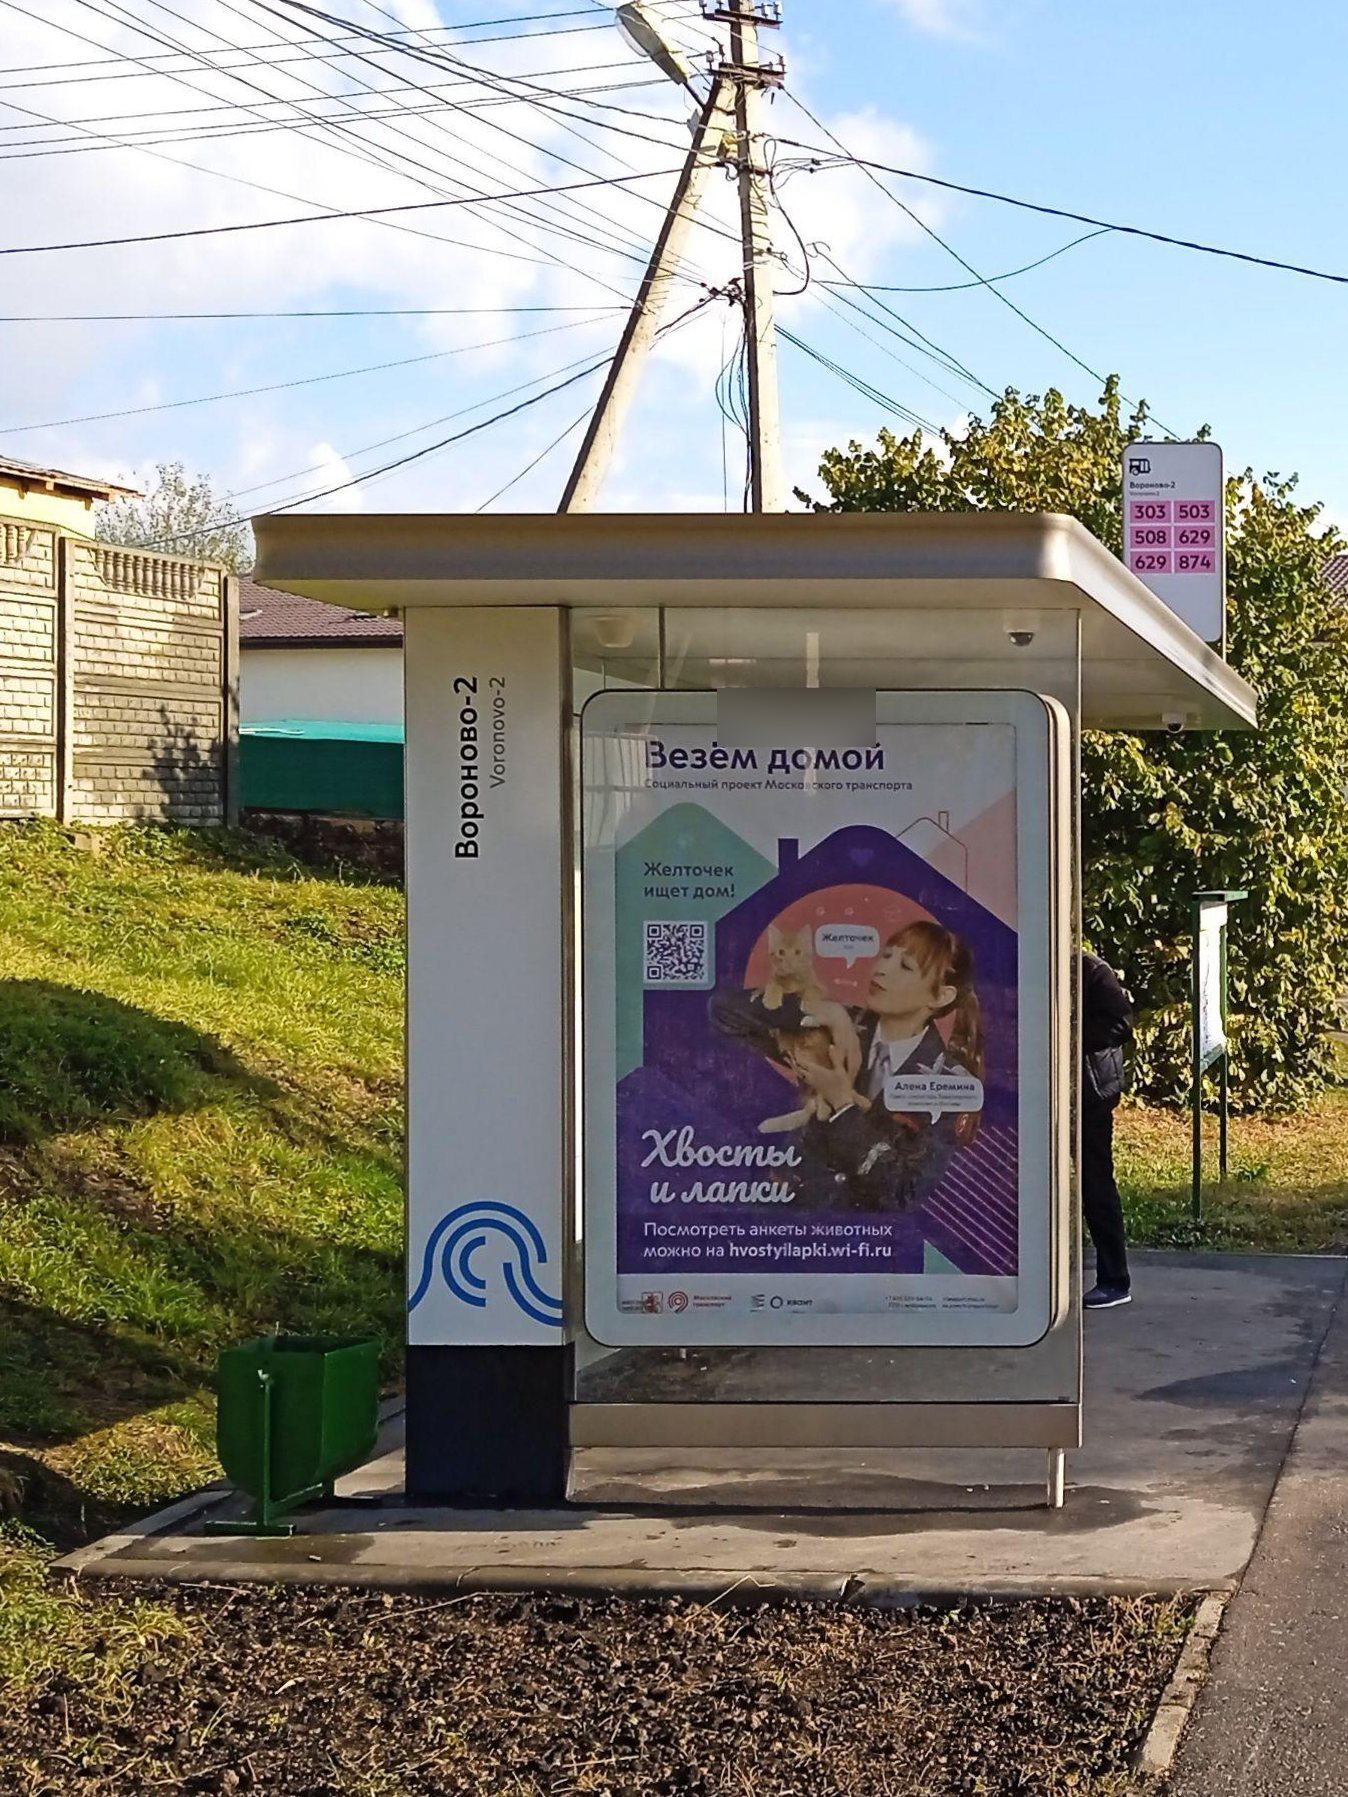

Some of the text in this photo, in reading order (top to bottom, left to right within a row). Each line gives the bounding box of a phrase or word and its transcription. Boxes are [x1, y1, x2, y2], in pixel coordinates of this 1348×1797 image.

[1134, 504, 1210, 519] 303 503
[1135, 529, 1211, 545] 508 629
[1135, 554, 1211, 570] 629 874
[489, 677, 506, 788] Voronovo-2
[645, 741, 884, 774] Везём домой
[453, 676, 485, 858] Вороново-2
[645, 779, 719, 790] Социальный
[721, 781, 762, 791] проект
[846, 782, 913, 791] транспорта
[643, 862, 734, 877] Желточек
[644, 883, 736, 900] ищет дом!
[821, 932, 874, 943] Желточек
[641, 1125, 802, 1168] Хвосты
[650, 1181, 796, 1204] и лапки
[643, 1222, 893, 1238] Посмотреть анкеты животных
[643, 1242, 893, 1260] можно на hvostyilapki.wi-fi.ru
